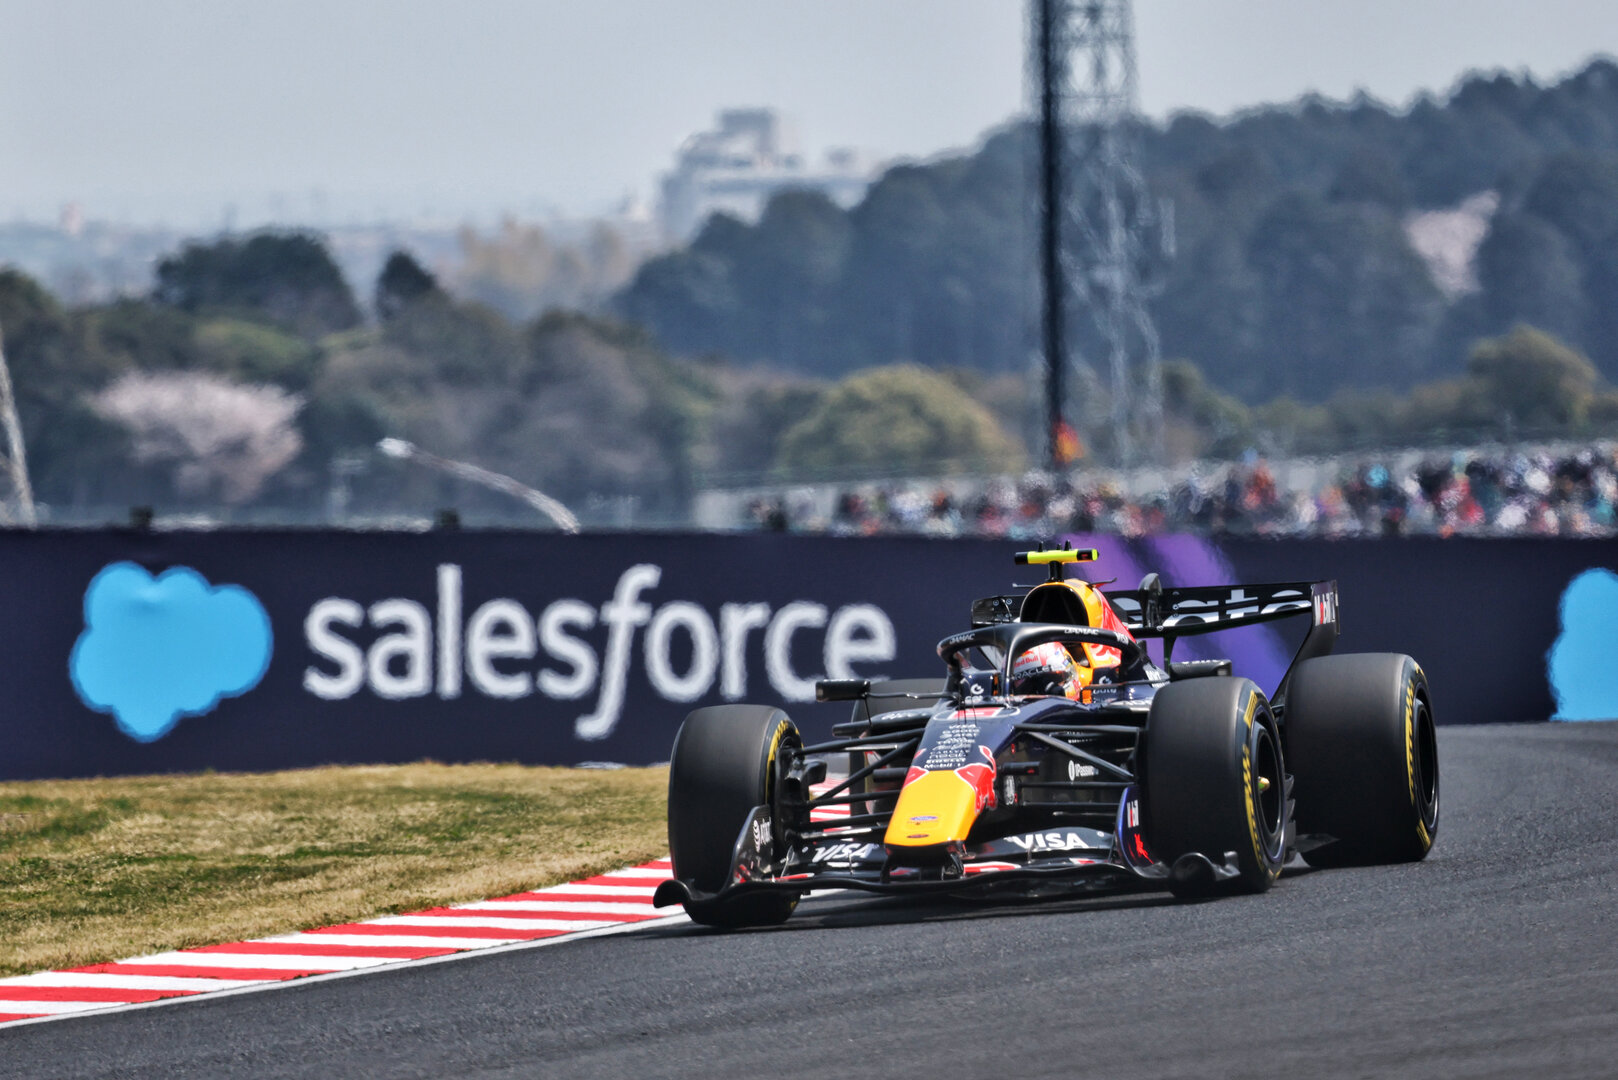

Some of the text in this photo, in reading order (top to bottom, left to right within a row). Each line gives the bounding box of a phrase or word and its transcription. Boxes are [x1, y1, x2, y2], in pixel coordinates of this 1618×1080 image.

[303, 564, 897, 740] salesforce
[1012, 666, 1050, 680] RACLE
[1004, 832, 1089, 849] VISA
[811, 842, 876, 863] VISA
